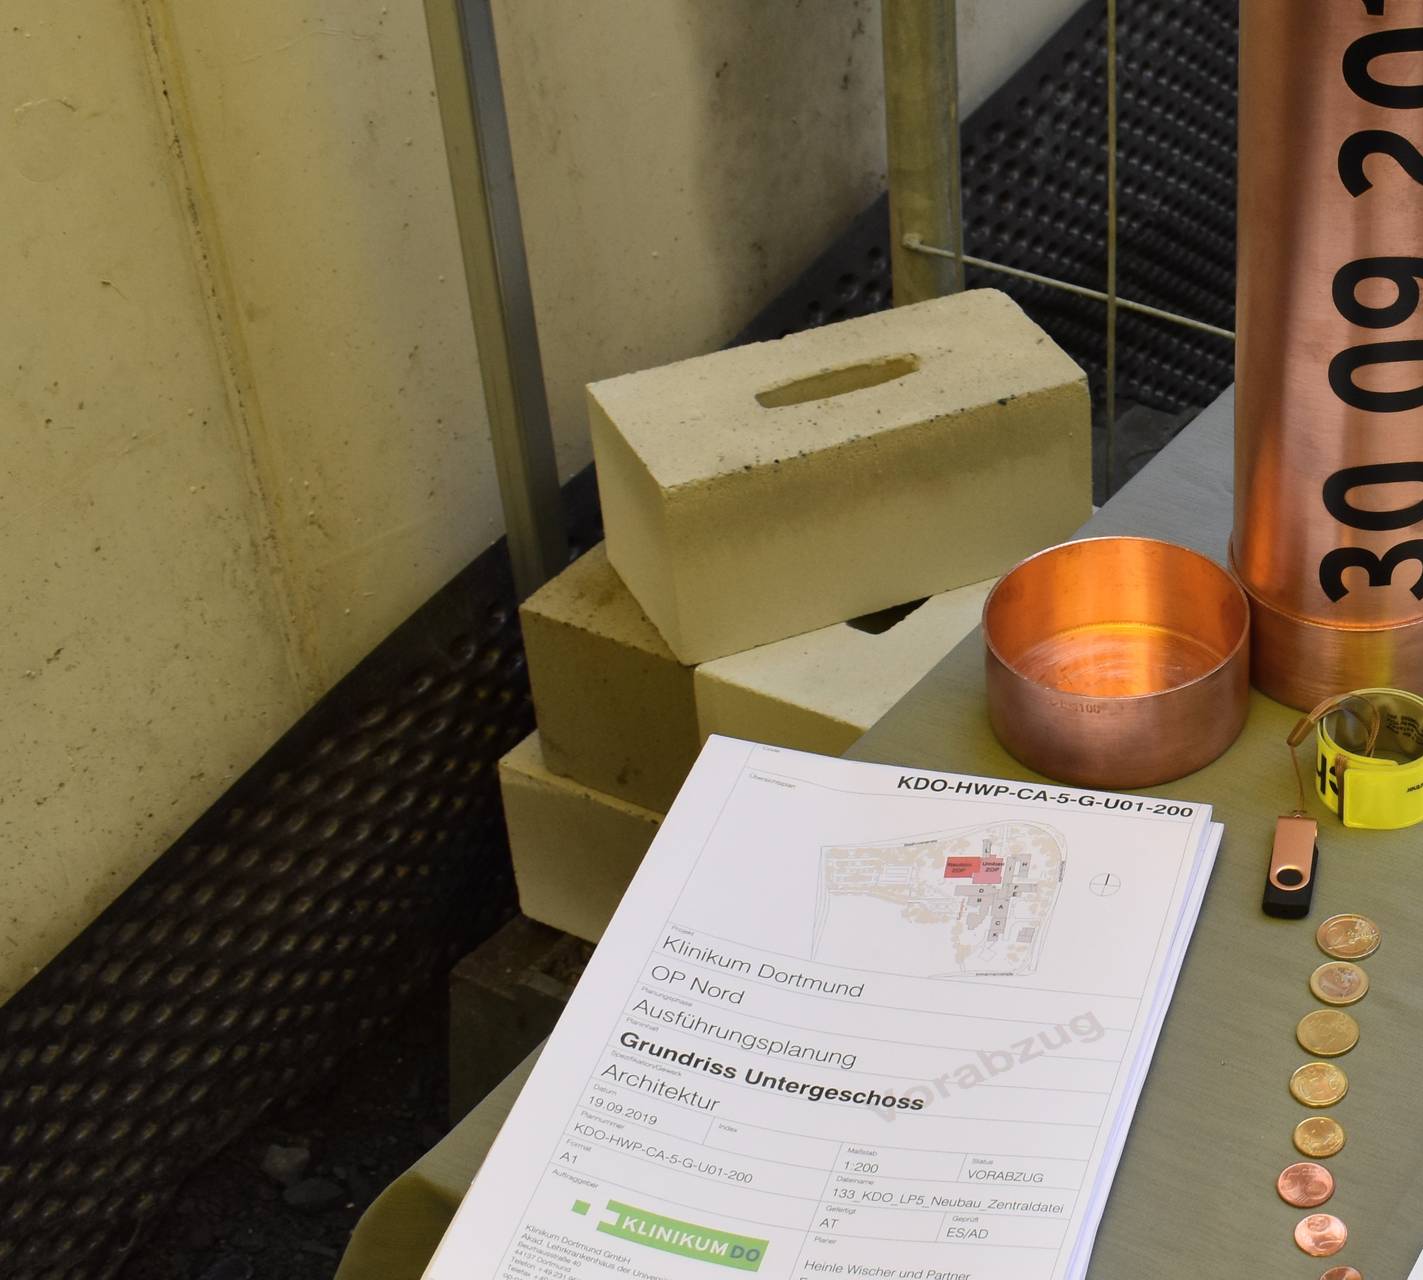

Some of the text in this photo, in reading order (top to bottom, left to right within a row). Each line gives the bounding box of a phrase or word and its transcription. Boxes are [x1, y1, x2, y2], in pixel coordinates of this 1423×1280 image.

[896, 775, 1194, 819] KDO-HWP-CA-5-G-U01-200
[651, 965, 745, 1005] OP Nord
[663, 935, 865, 999] Klinikum Dortmund
[632, 998, 858, 1070] Ausführungsplanung
[601, 1063, 721, 1112] Architektur
[620, 1030, 926, 1112] Grundriss Untergeschoss
[588, 1095, 658, 1126] 19.09.2019
[559, 1151, 579, 1165] A1
[574, 1122, 754, 1184] KDO-HWP-CA-5-G-U01-200
[967, 1168, 1045, 1184] VORABZUG
[819, 1218, 840, 1230] AT
[946, 1227, 990, 1240] ES/AD
[804, 1259, 844, 1275] Heinle
[847, 1264, 896, 1279] Wischer
[899, 1267, 923, 1280] und
